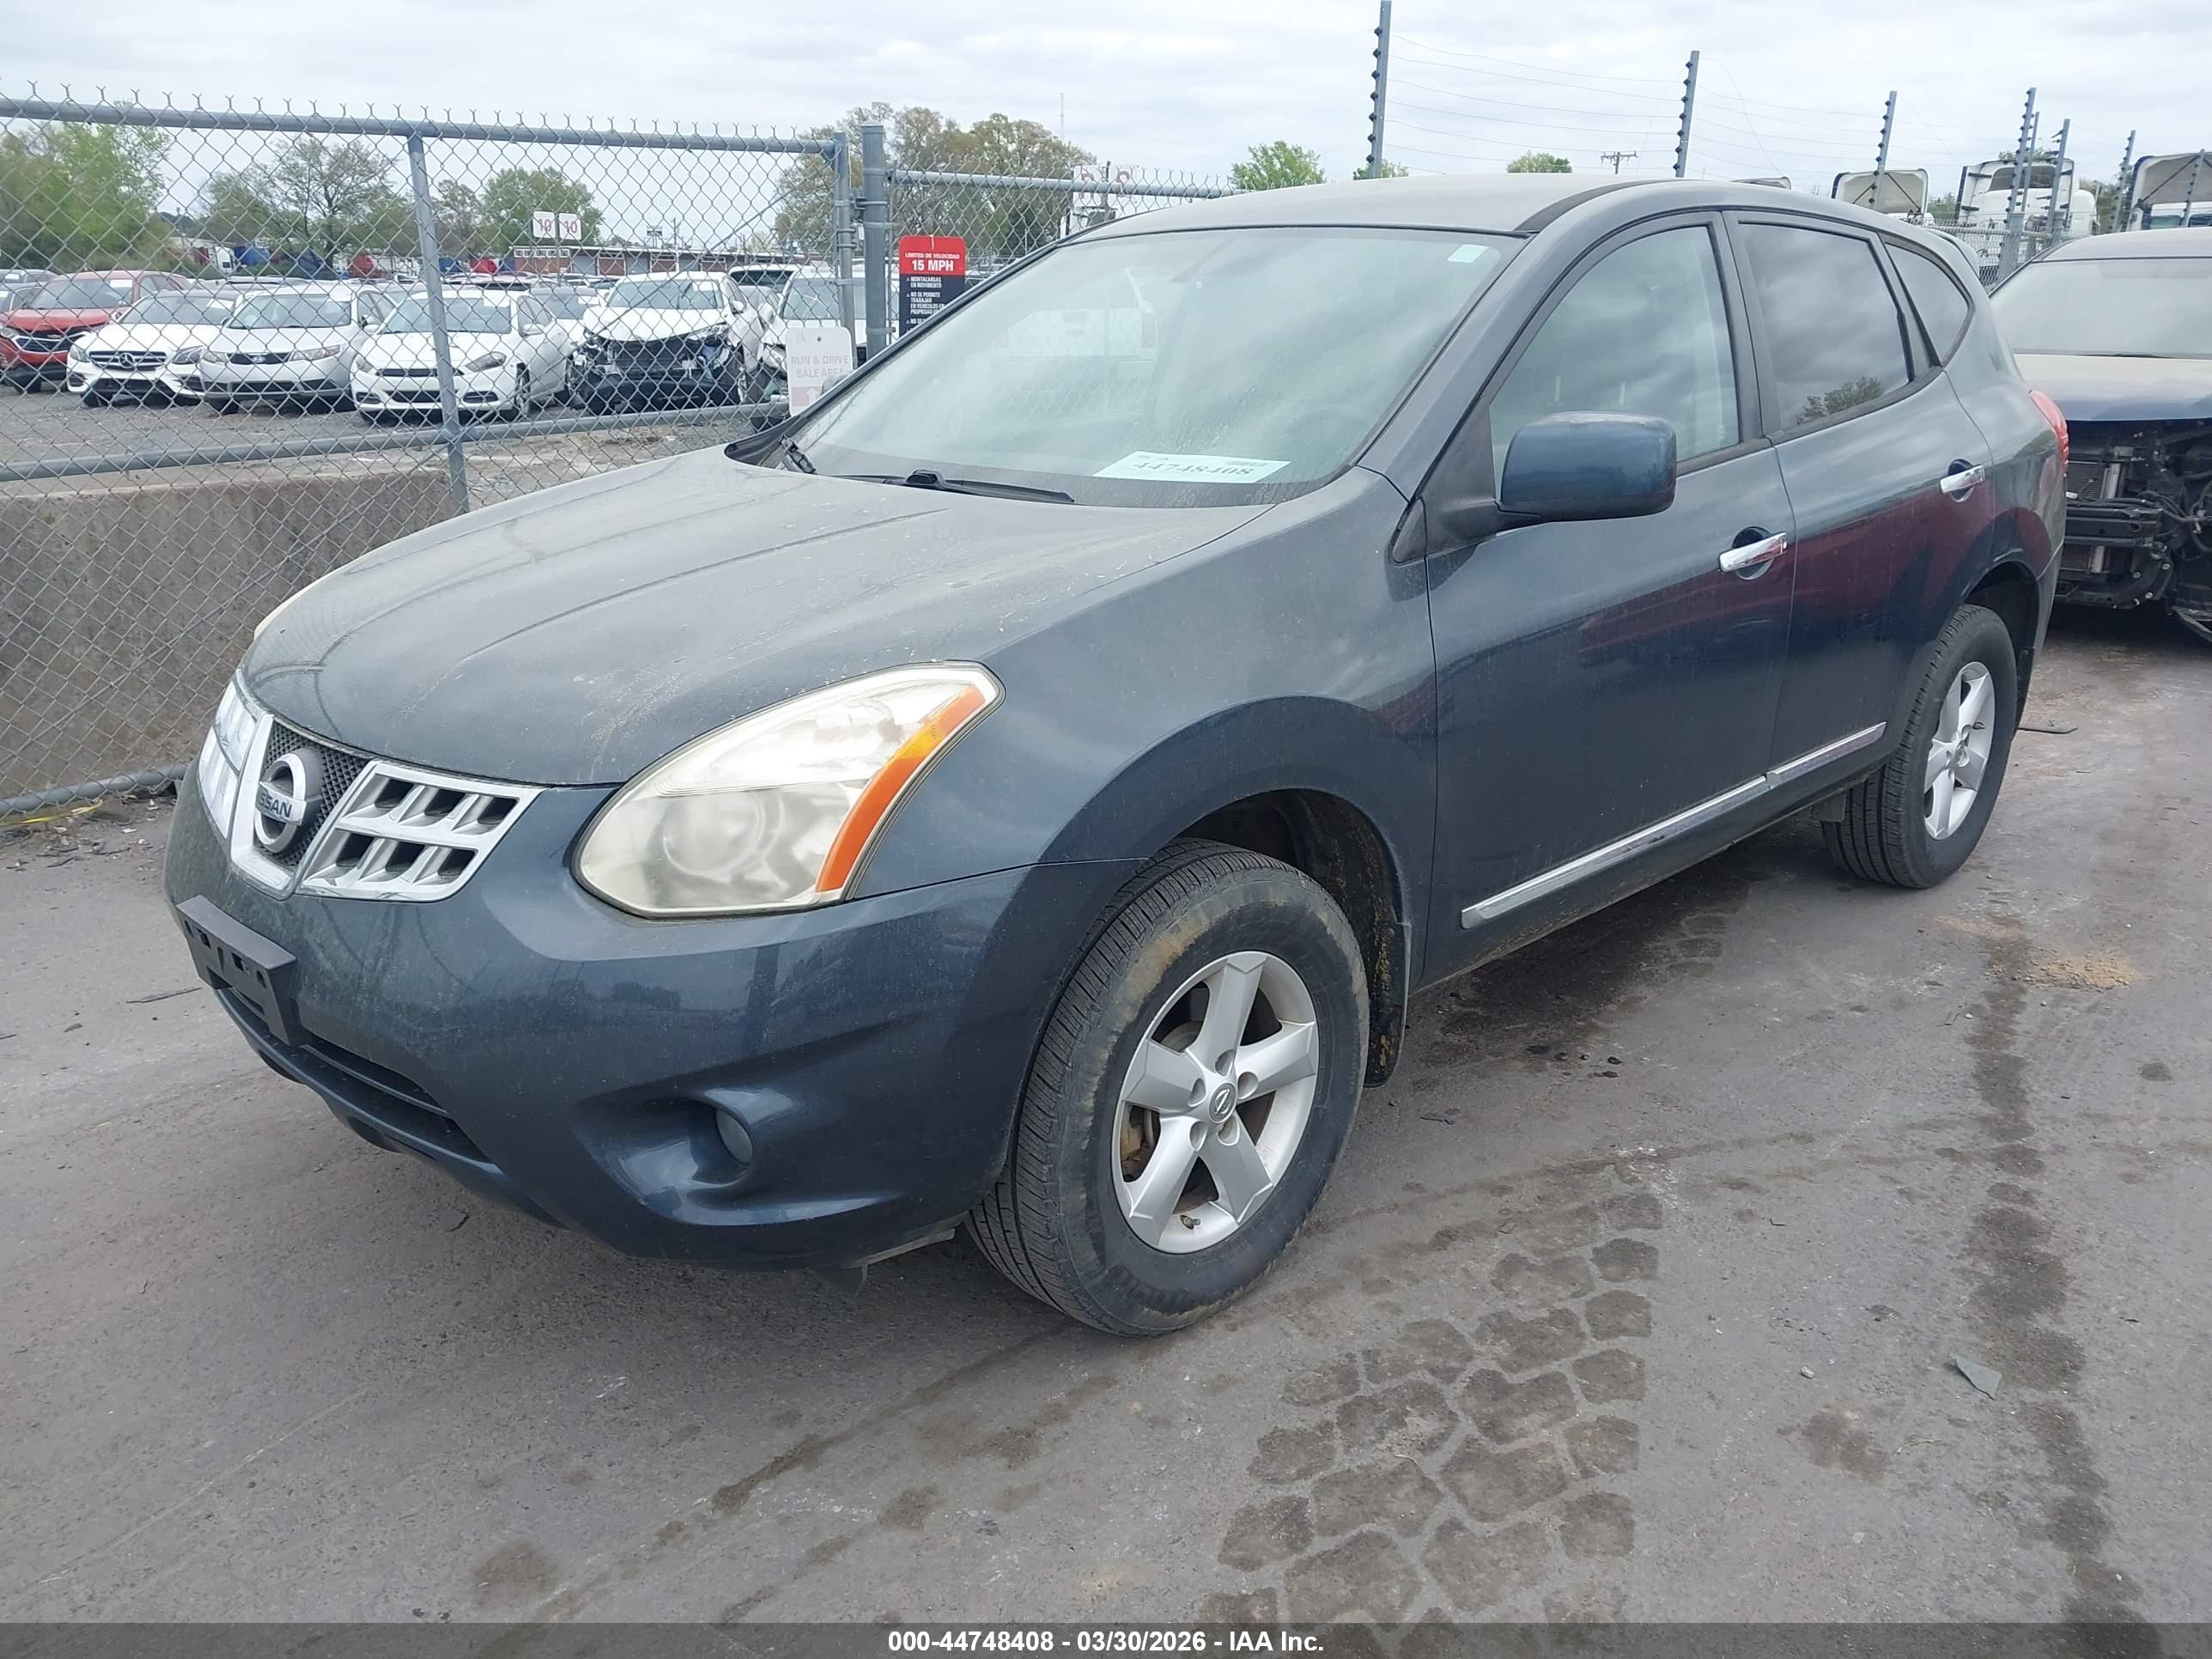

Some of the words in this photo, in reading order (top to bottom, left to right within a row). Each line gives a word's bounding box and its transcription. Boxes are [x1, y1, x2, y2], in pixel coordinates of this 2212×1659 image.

[912, 259, 925, 270] 15
[927, 259, 954, 271] MPH
[791, 356, 811, 365] RUN
[813, 356, 819, 365] &
[823, 356, 849, 364] DRIVE
[797, 369, 818, 378] SALE
